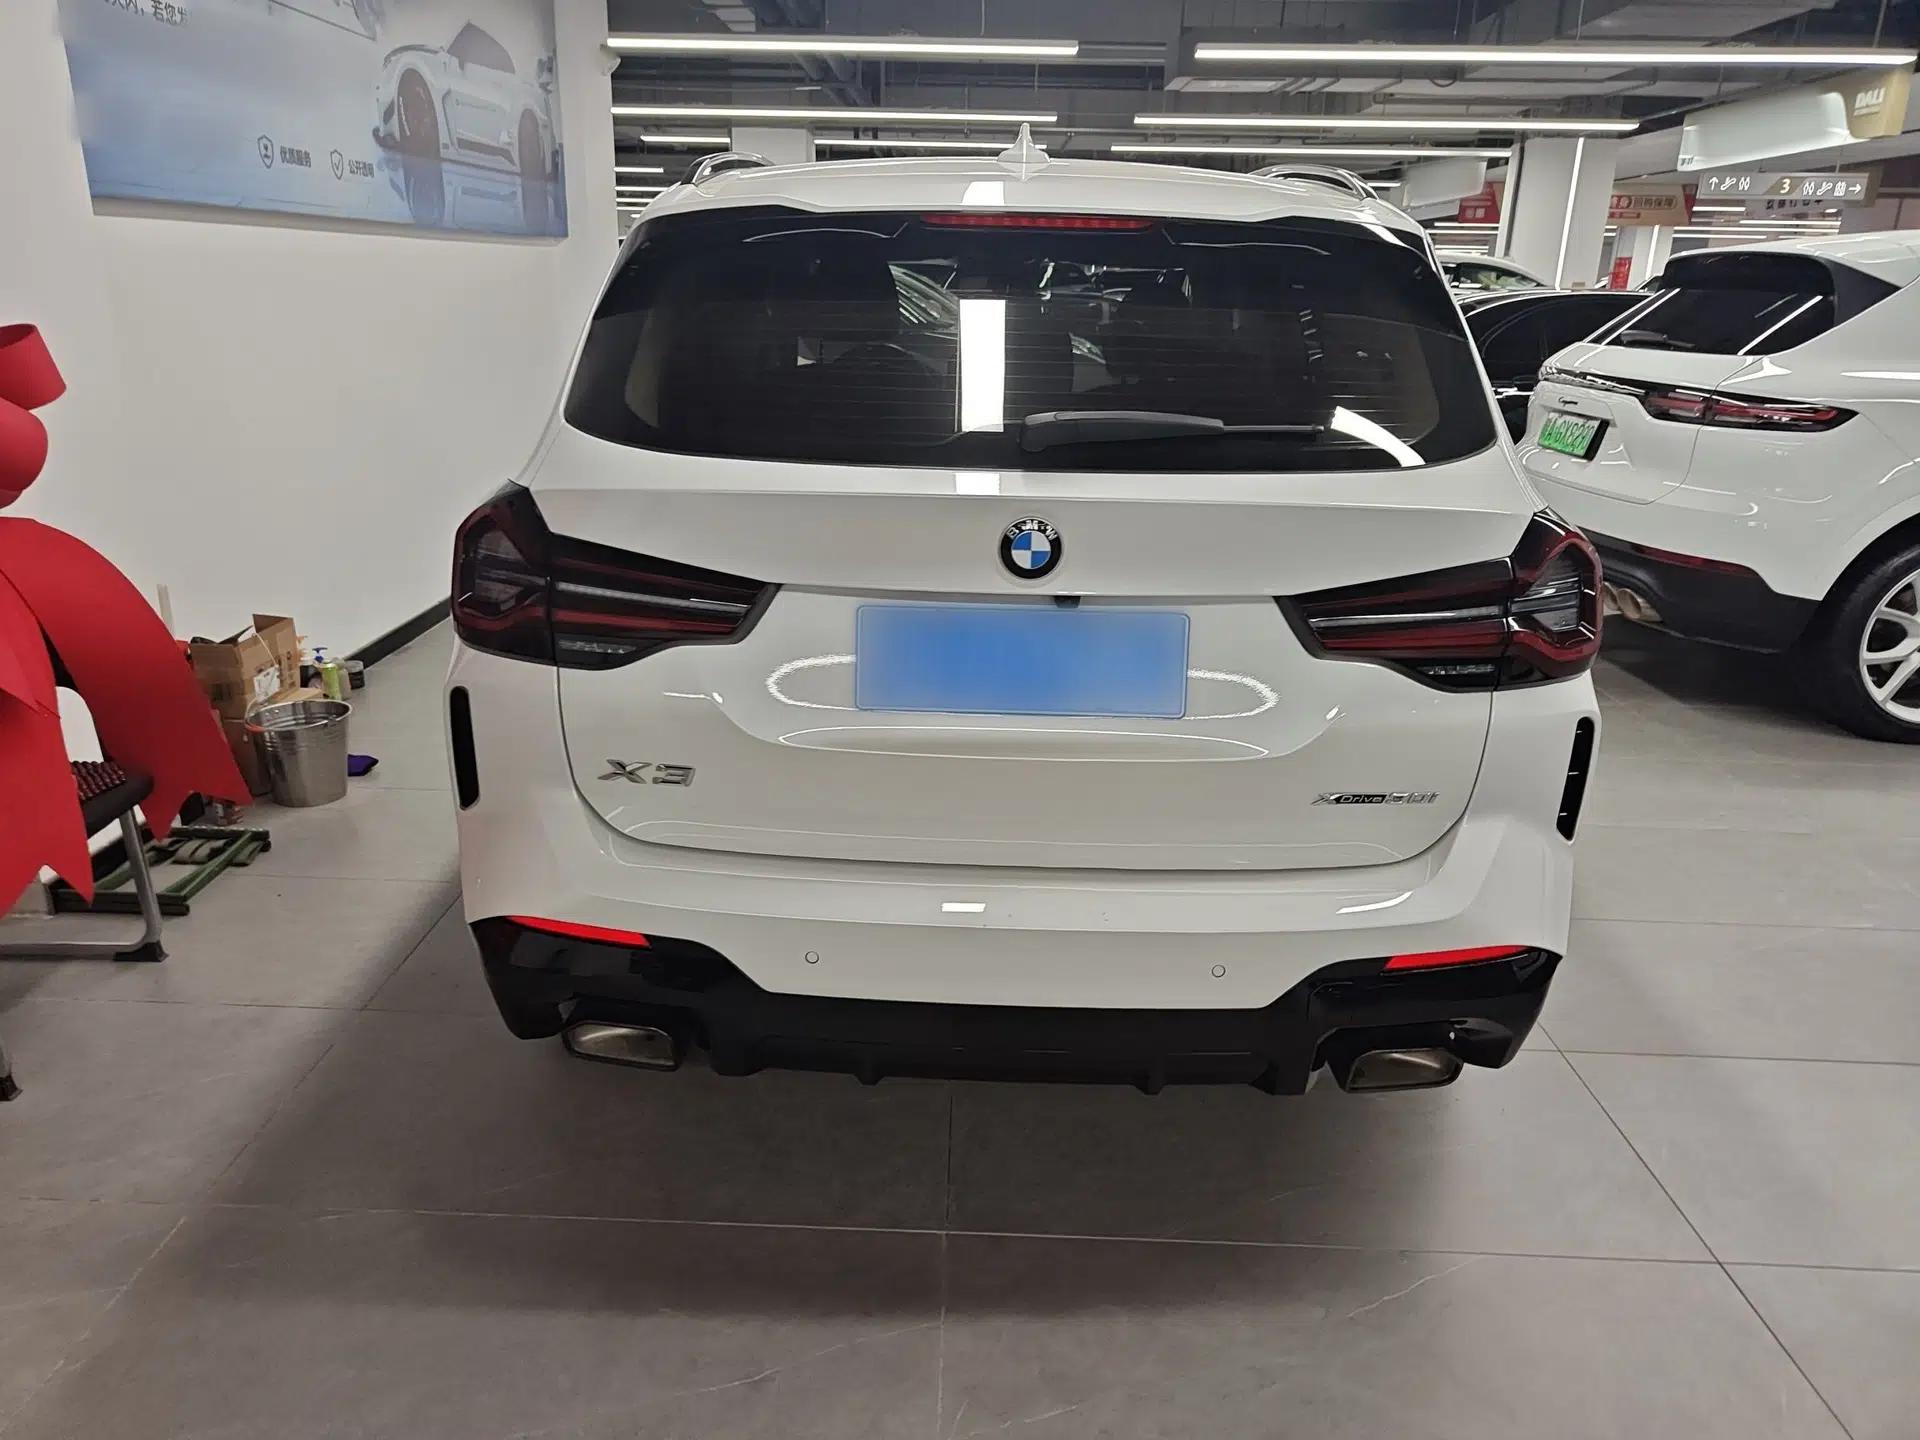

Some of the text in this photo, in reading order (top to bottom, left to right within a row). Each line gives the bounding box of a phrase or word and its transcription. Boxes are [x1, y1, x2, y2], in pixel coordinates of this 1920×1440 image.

[1780, 178, 1791, 194] 3
[1005, 519, 1058, 540] BMW
[597, 759, 697, 788] X3
